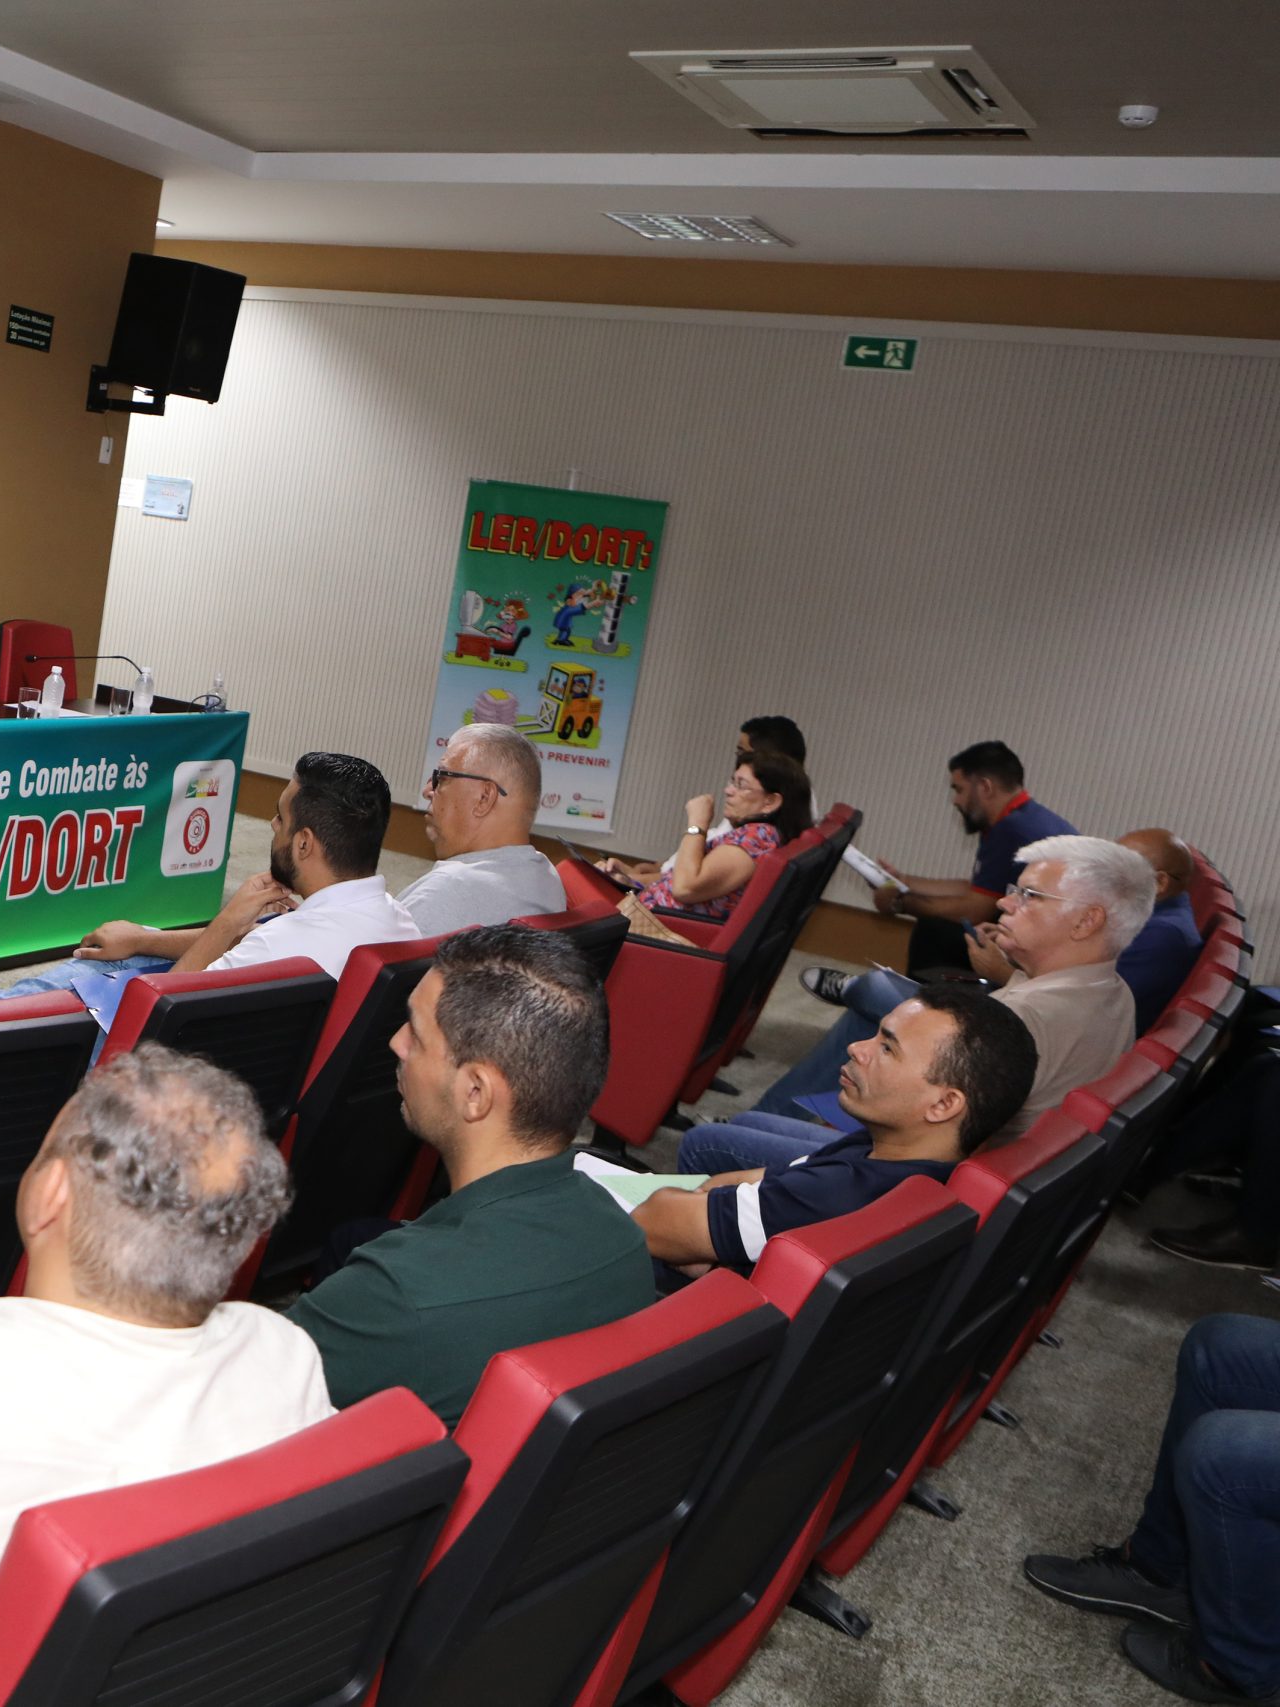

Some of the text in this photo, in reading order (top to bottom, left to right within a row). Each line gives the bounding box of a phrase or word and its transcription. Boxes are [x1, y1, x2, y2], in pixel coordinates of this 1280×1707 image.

[467, 510, 654, 571] LER/DORT:
[18, 756, 118, 799] Combate
[122, 753, 150, 790] às
[547, 751, 610, 768] PREVENIR!
